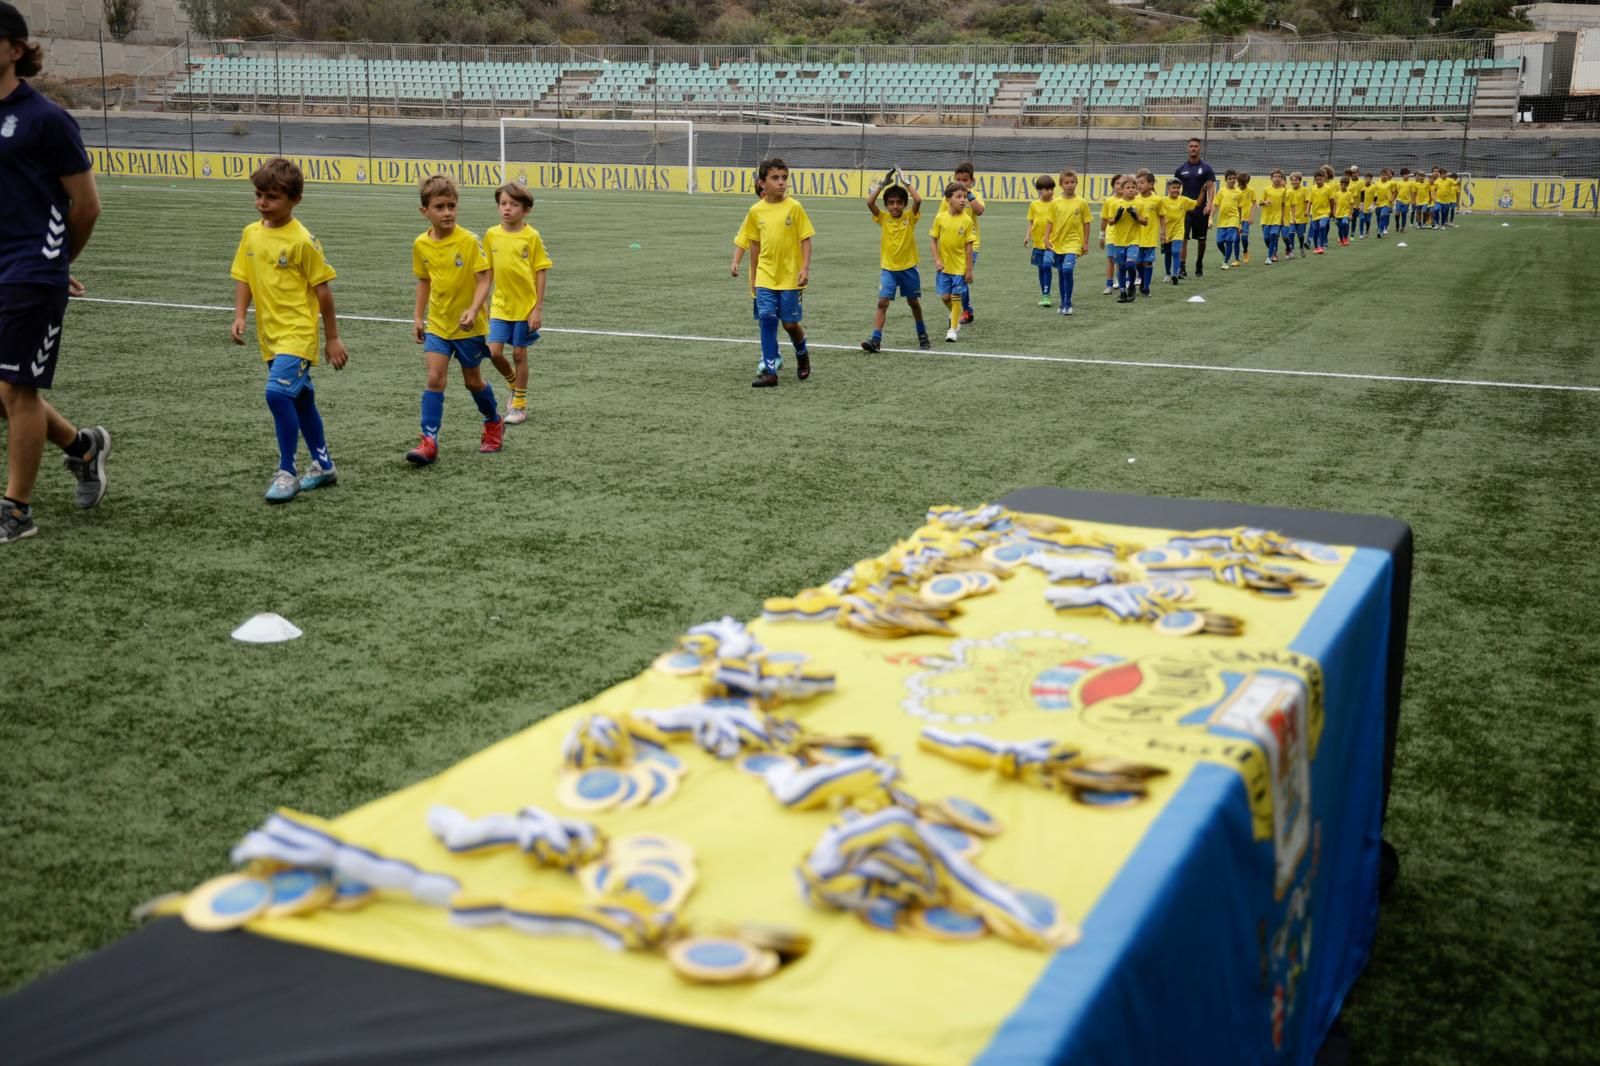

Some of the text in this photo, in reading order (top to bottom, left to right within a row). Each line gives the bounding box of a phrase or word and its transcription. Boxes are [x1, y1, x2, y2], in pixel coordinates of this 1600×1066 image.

[100, 151, 125, 173] LAS
[128, 152, 188, 176] PALMAS
[223, 156, 244, 177] UD
[291, 158, 342, 180] LMAS
[378, 160, 400, 183] UD
[540, 166, 670, 191] UD LAS PALMAS
[711, 170, 849, 196] UD LA ALMAS
[974, 175, 1041, 200] ALMAS
[1532, 182, 1599, 209] UD LA
